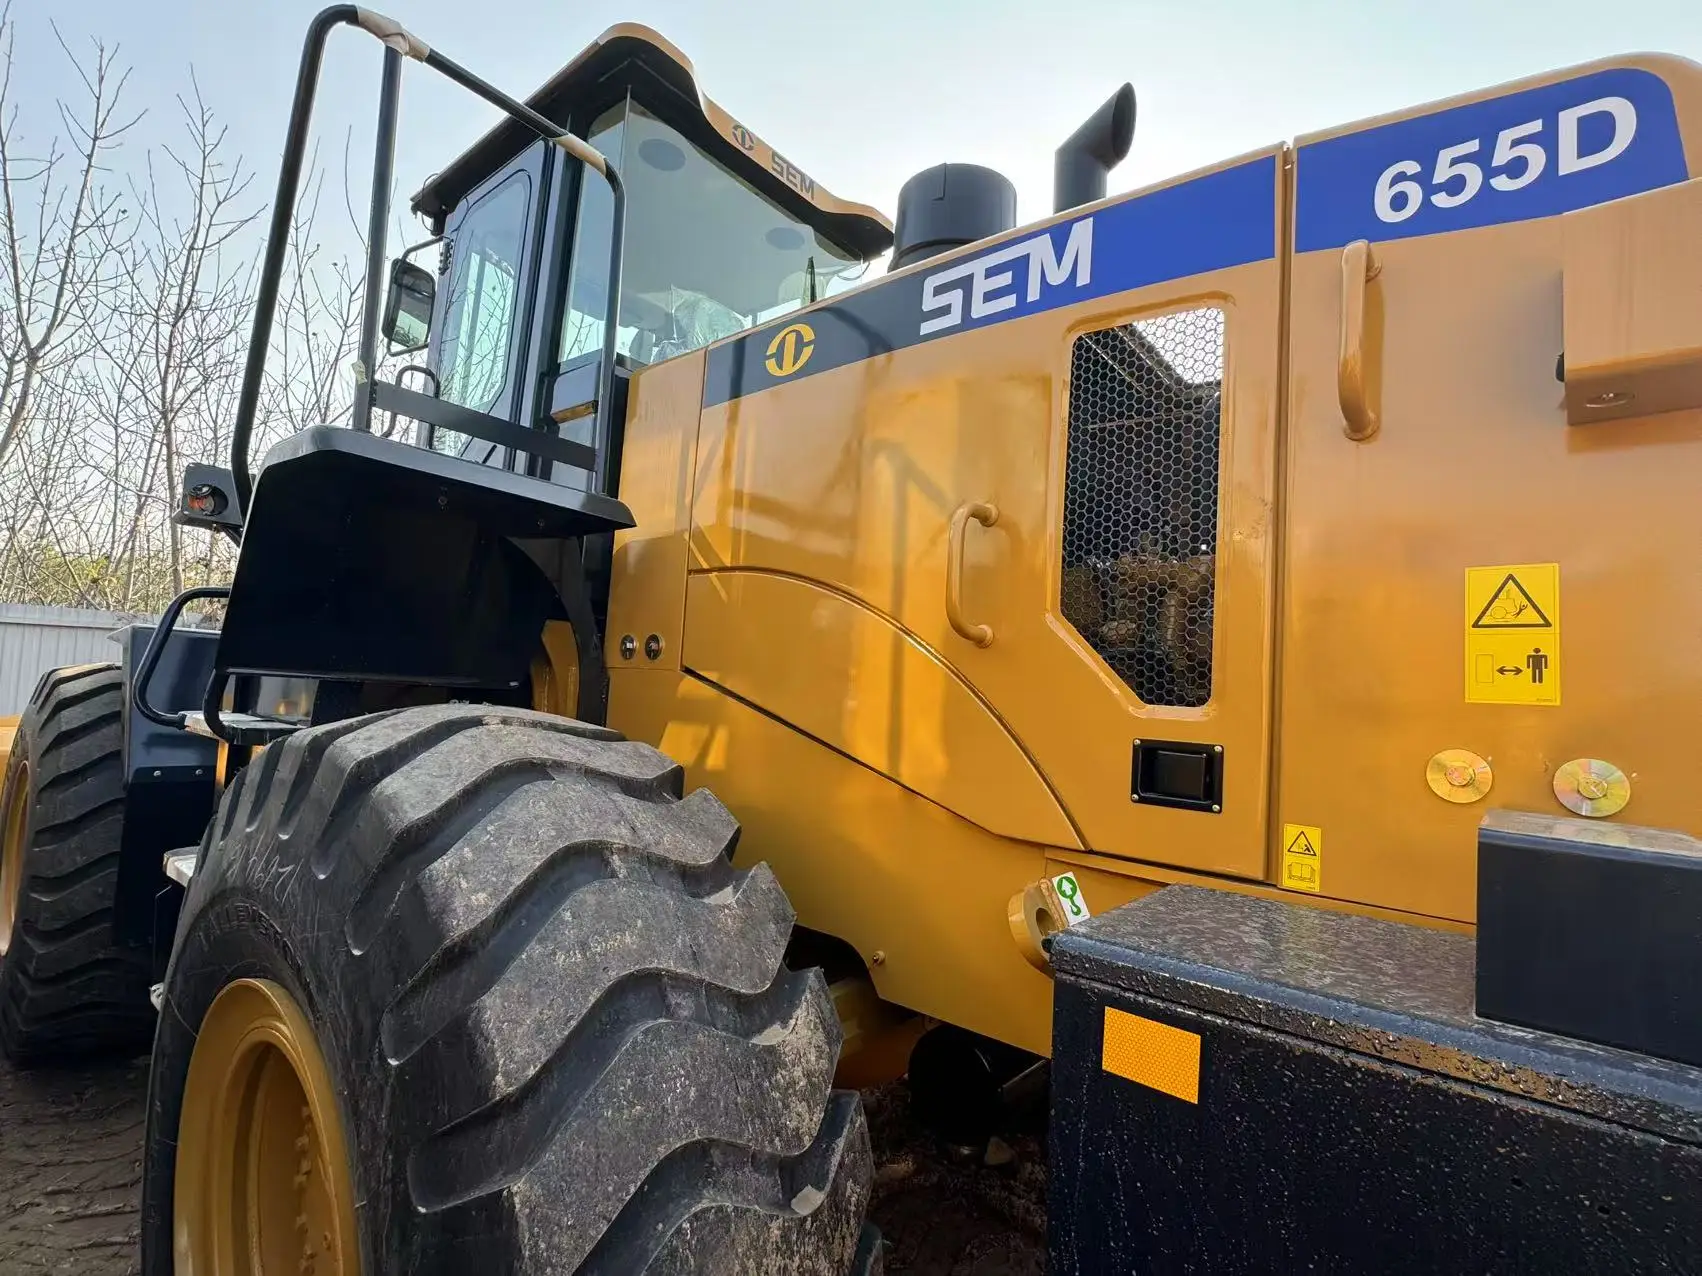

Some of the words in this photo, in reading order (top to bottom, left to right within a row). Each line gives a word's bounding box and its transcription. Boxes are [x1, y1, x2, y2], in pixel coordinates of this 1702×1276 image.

[771, 150, 815, 200] SEM
[1374, 96, 1637, 223] 655D
[920, 217, 1093, 336] SEM
